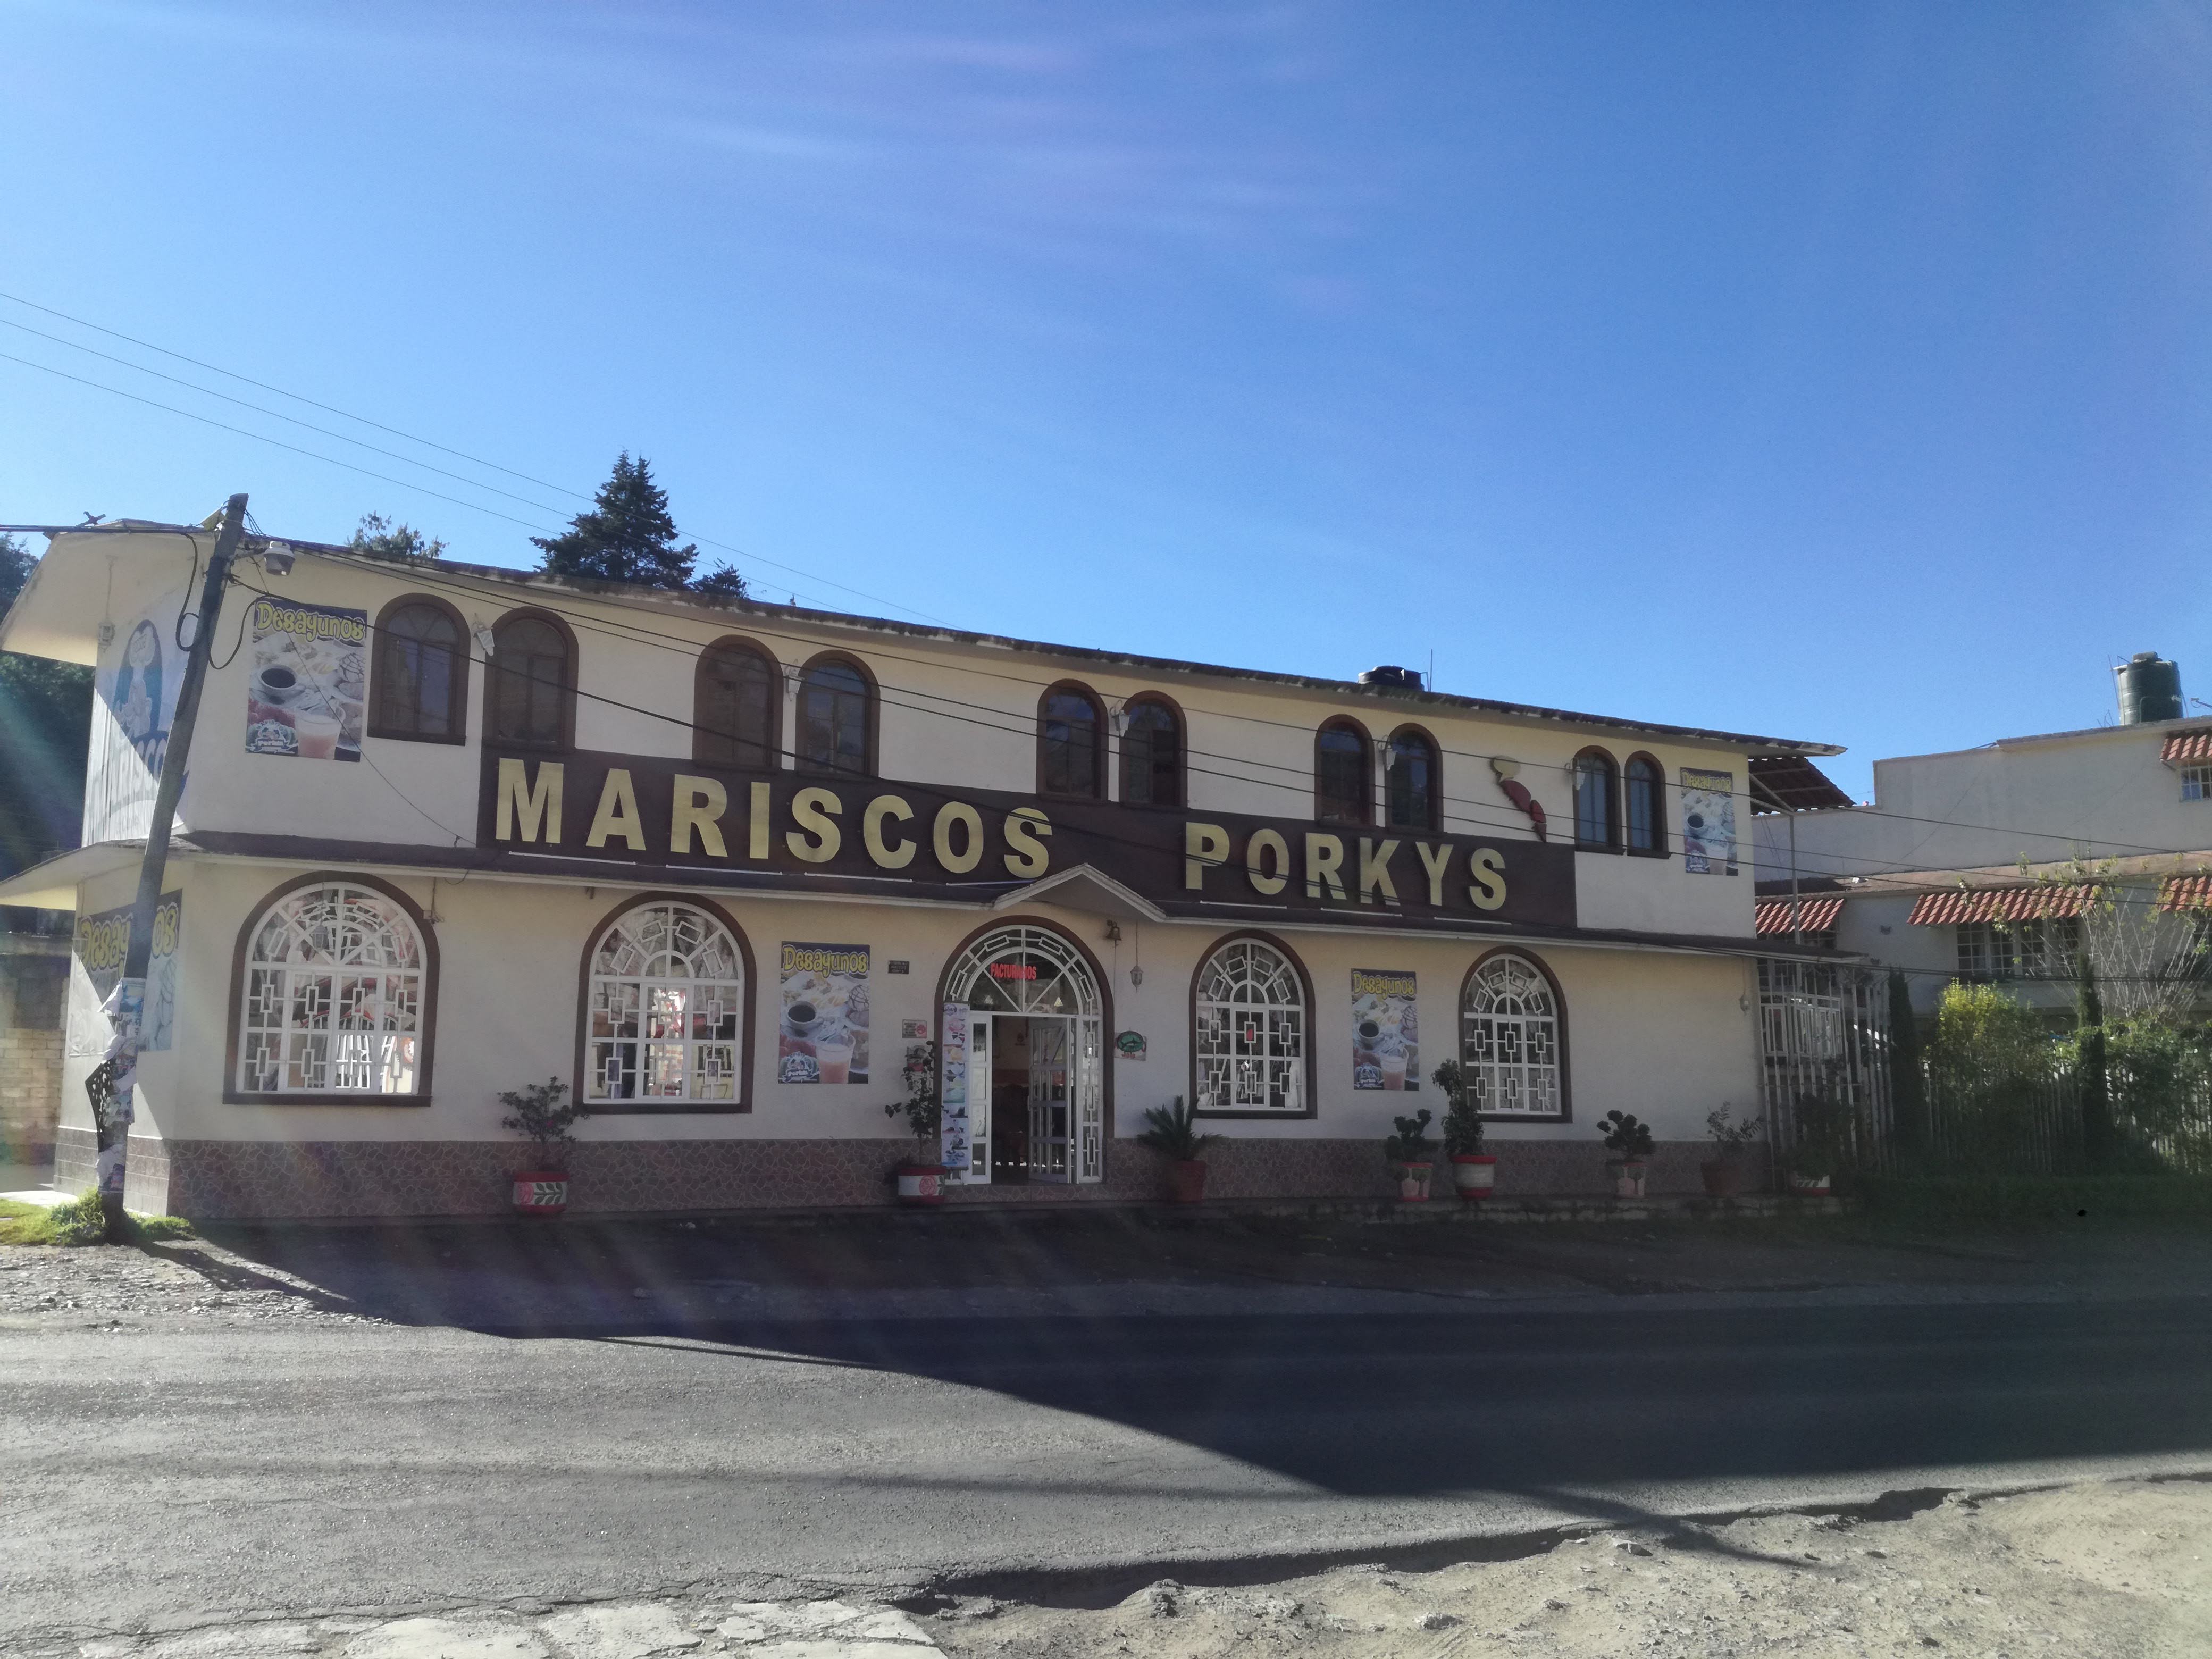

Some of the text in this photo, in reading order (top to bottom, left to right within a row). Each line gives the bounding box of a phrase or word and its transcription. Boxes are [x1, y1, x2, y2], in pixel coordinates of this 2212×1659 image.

[257, 601, 365, 641] Desayunos
[496, 758, 1506, 910] MARISCOS PORKYS
[79, 902, 179, 978] Desayos
[782, 944, 868, 978] Desayunos
[1353, 971, 1414, 999] Desayunos
